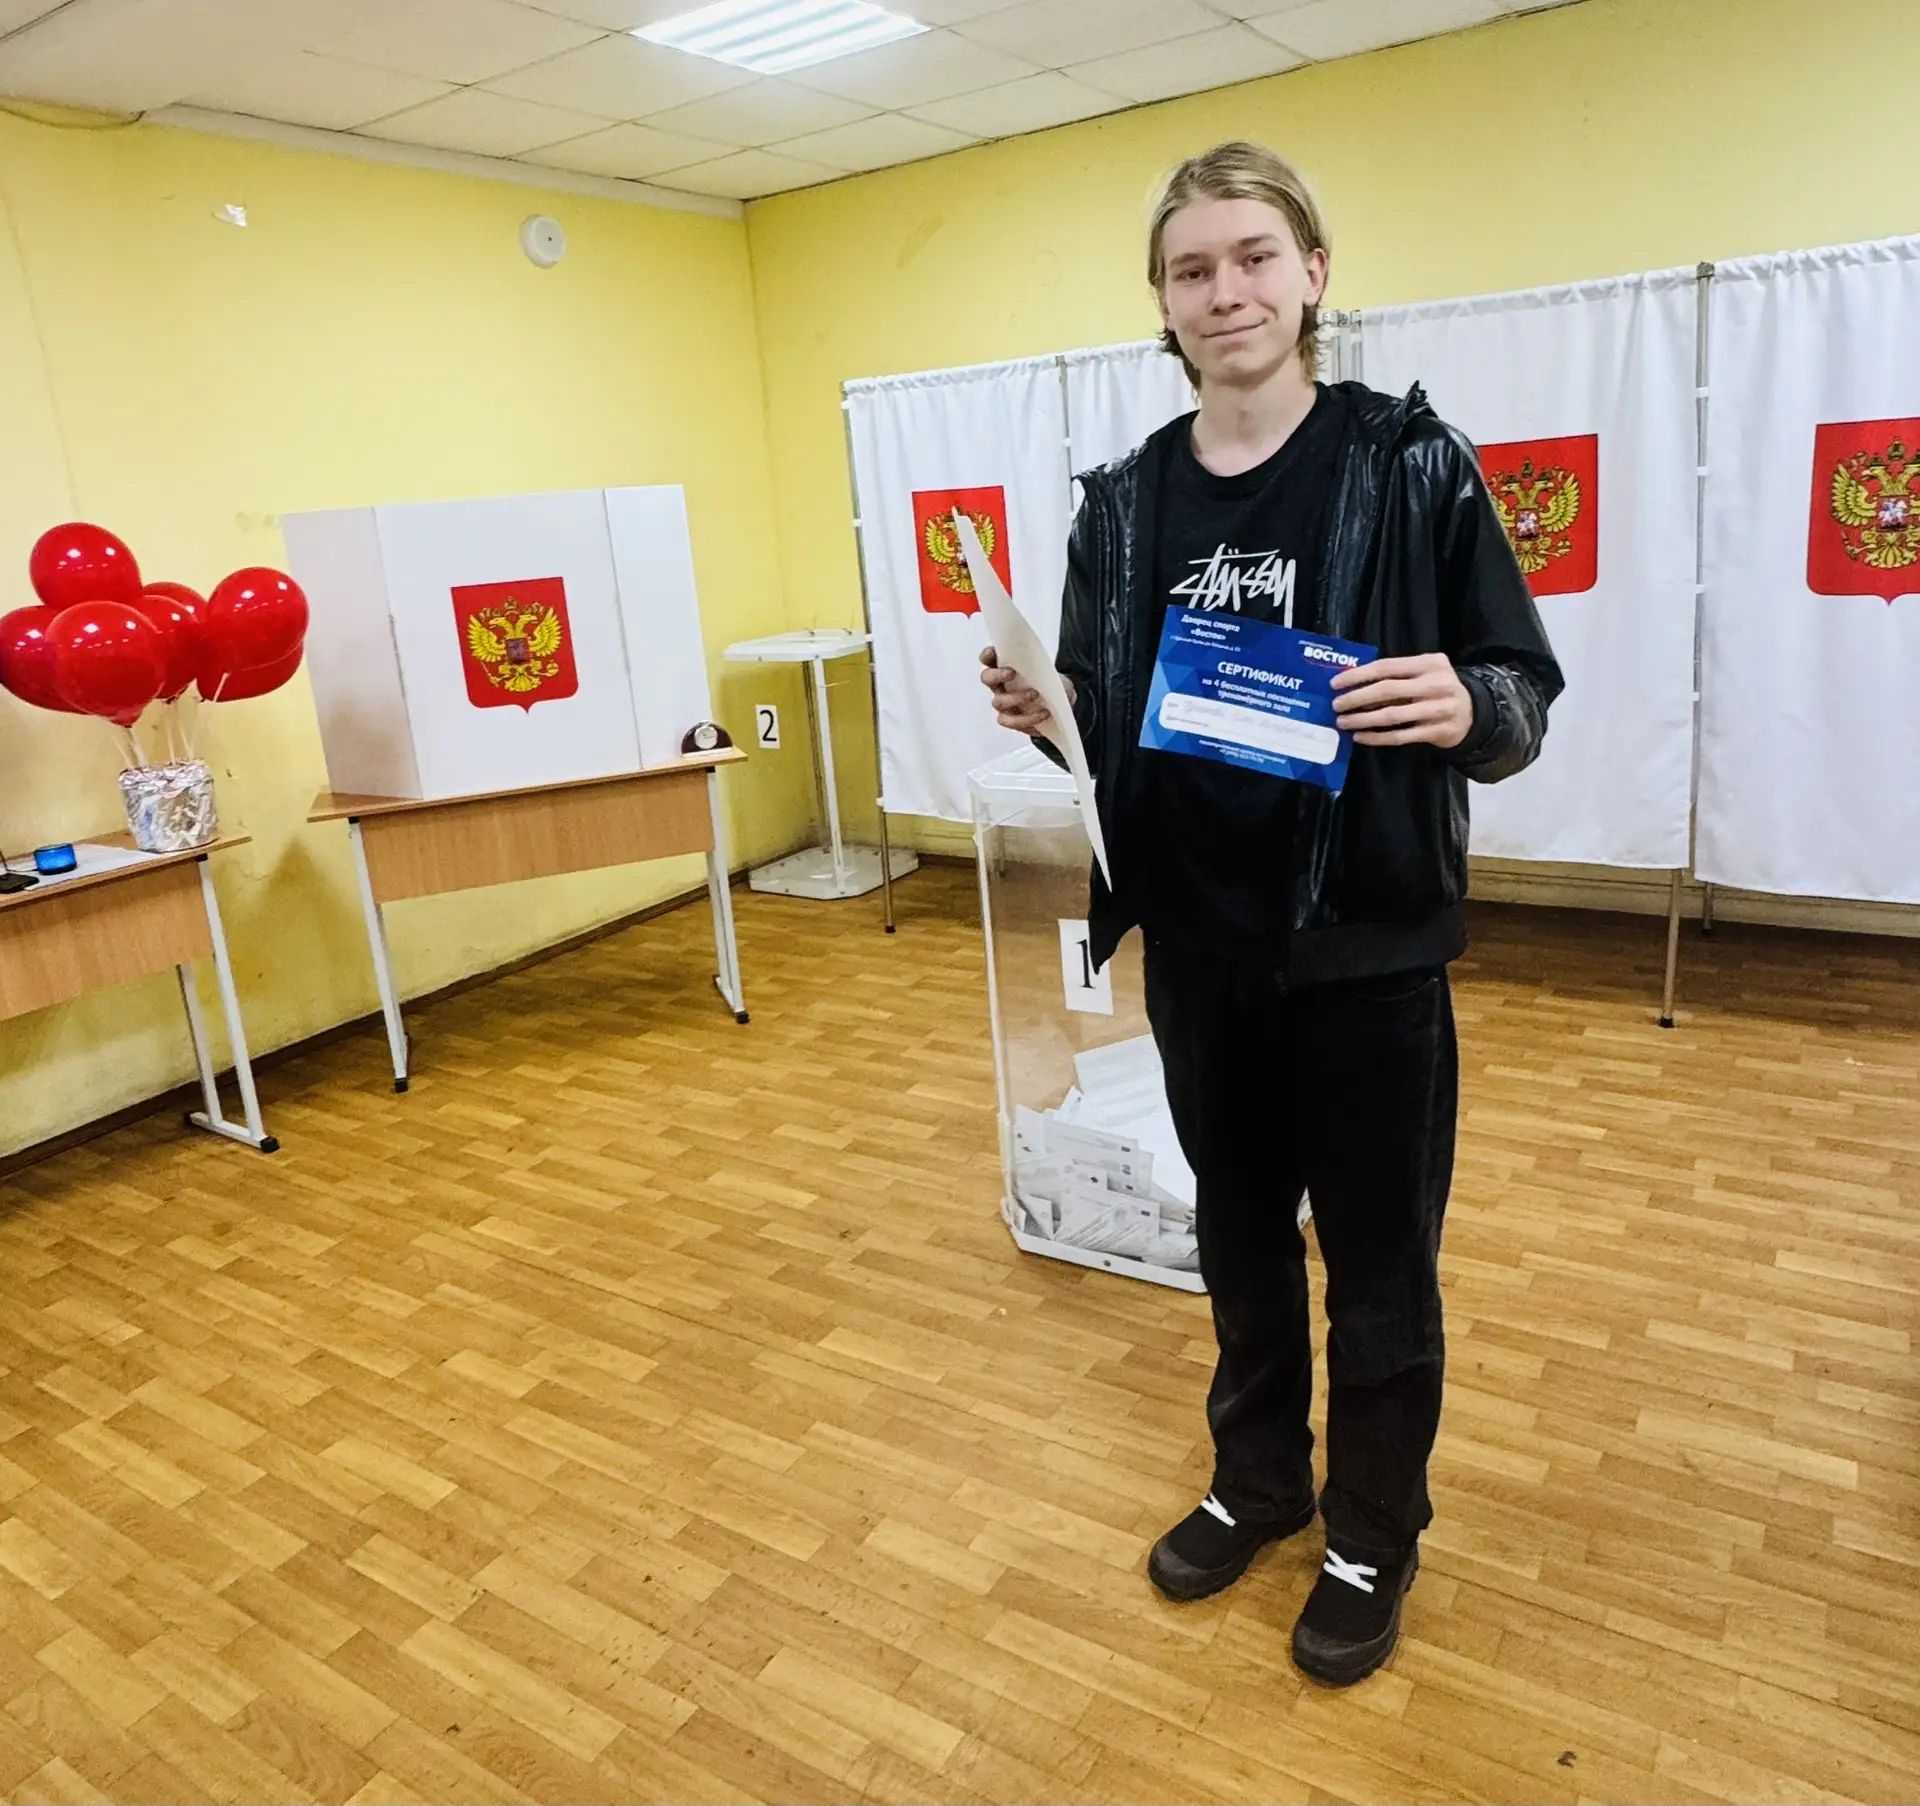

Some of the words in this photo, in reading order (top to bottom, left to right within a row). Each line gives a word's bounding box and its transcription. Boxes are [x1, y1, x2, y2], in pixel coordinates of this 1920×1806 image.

[1181, 614, 1212, 627] Дворец
[1213, 621, 1240, 632] спорта
[1303, 646, 1360, 668] ВОСТОК
[1202, 678, 1212, 686] на
[1213, 679, 1220, 687] 4
[1217, 661, 1304, 691] СЕРТИФИКАТ
[759, 709, 777, 742] 2
[1075, 938, 1097, 990] 1
